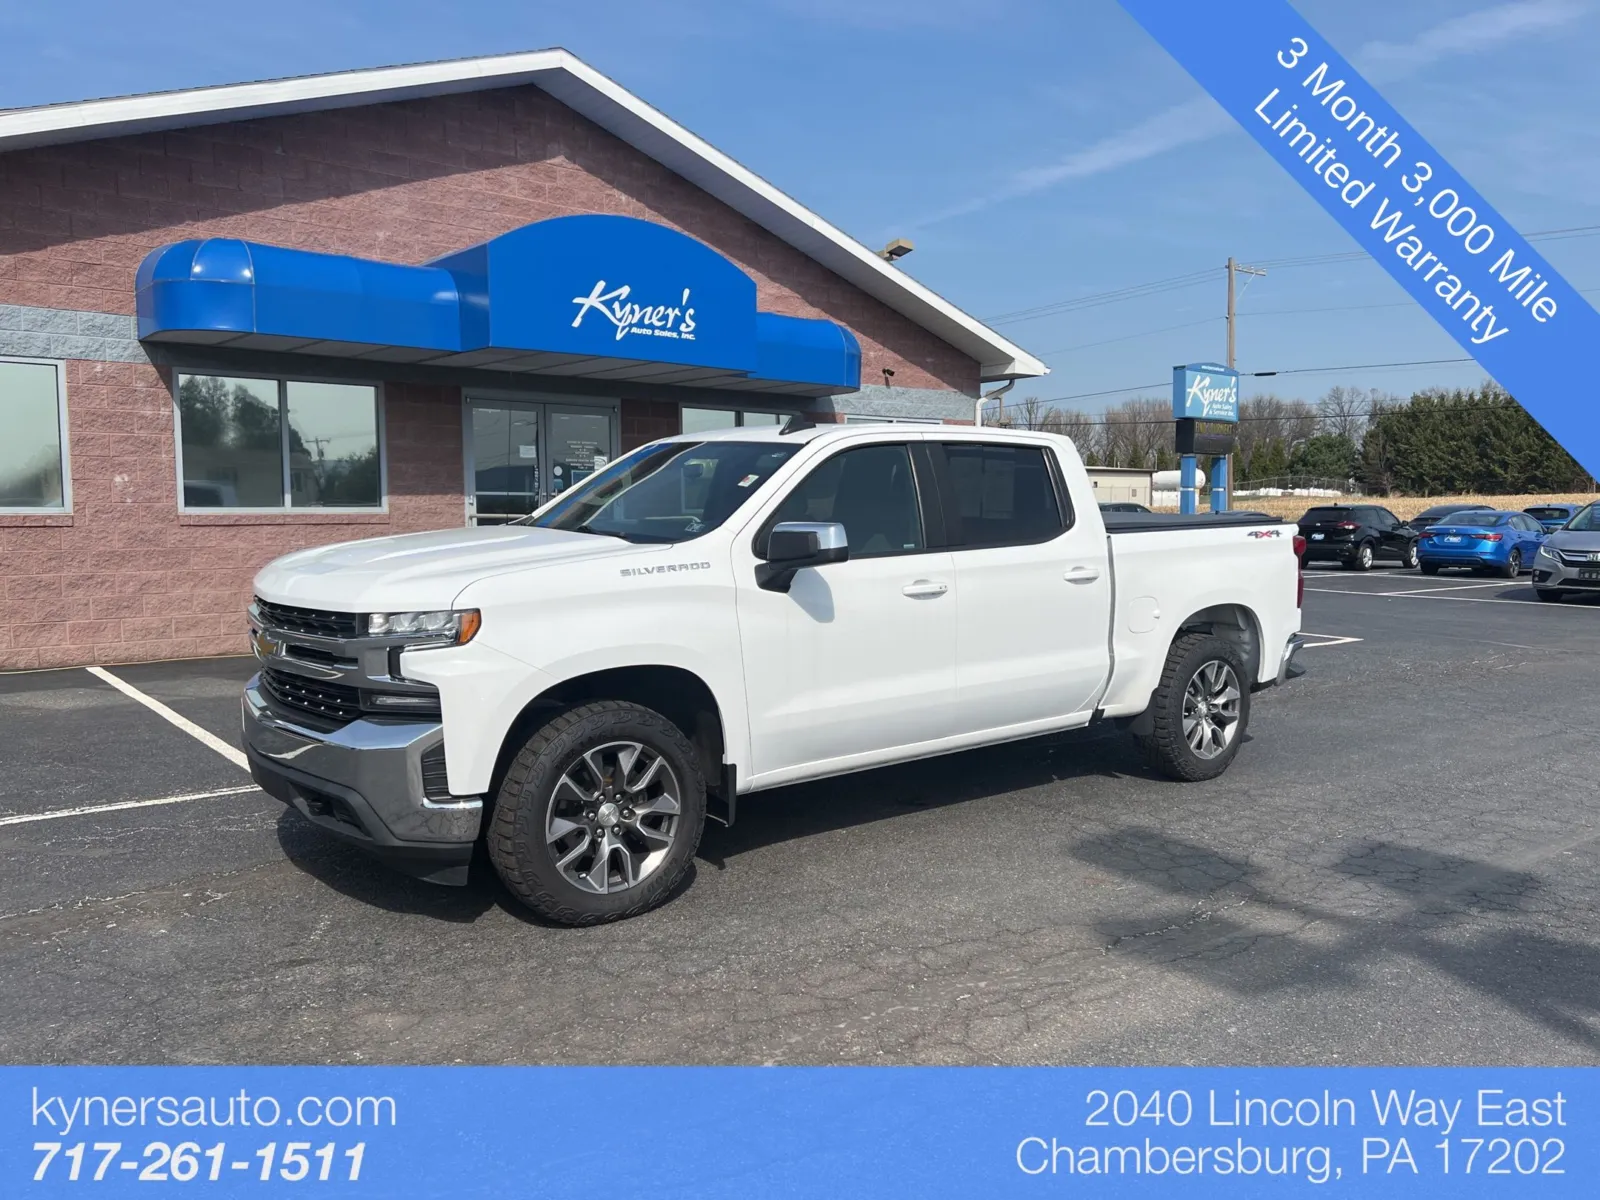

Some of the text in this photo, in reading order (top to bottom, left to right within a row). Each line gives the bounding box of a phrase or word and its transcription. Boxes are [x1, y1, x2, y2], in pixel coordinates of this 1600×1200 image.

[571, 279, 697, 341] Kyner's
[630, 326, 696, 341] Auto Sales, Inc.
[1186, 374, 1237, 417] Kyner's
[619, 561, 711, 577] SILVERADO
